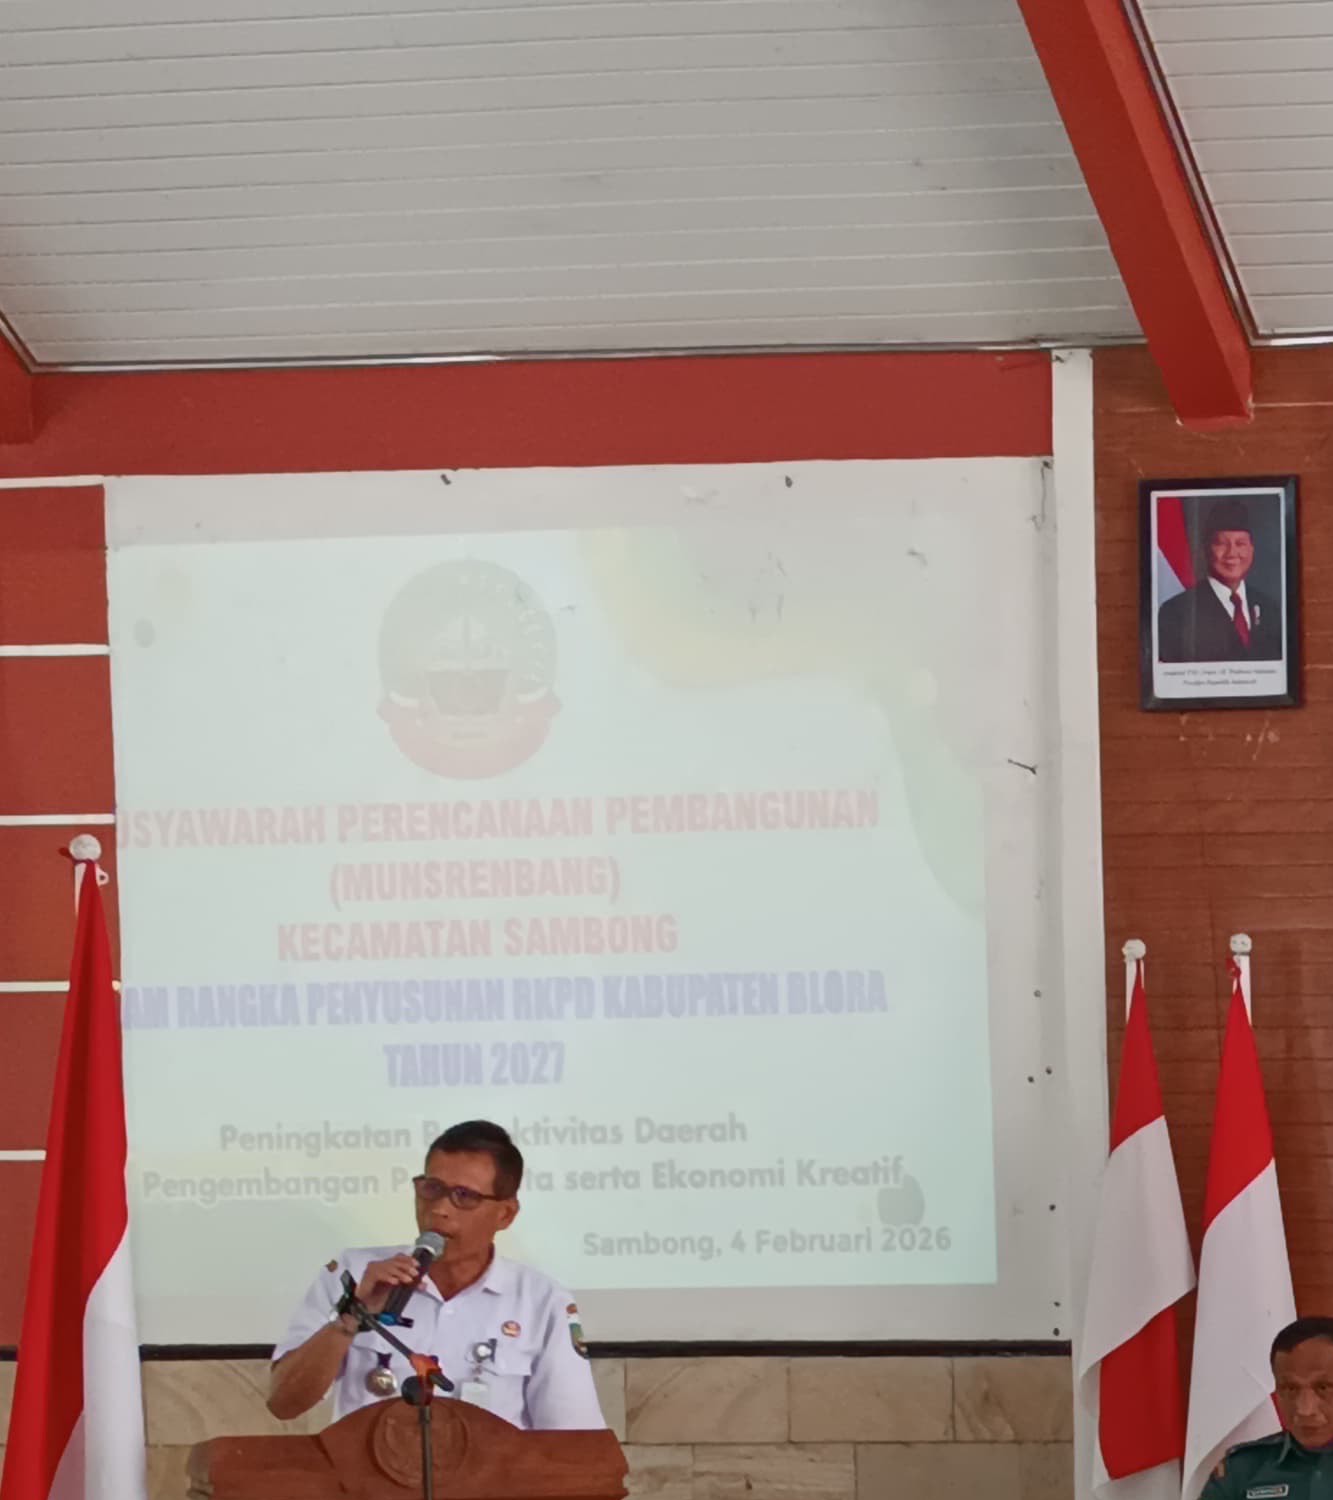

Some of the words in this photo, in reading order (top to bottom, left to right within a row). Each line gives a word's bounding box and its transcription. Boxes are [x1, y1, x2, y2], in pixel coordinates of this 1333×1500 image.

[336, 799, 594, 844] PERENCANAAN
[605, 790, 880, 835] PEMBANGUNAN
[328, 854, 623, 912] (MUNSRENBANG)
[276, 917, 493, 963] KECAMATAN
[503, 914, 679, 956] SAMBONG
[175, 982, 301, 1029] RANGKA
[306, 978, 506, 1027] PENYUSUNAN
[513, 975, 596, 1021] RKPD
[602, 971, 780, 1019] KABUPATEN
[786, 969, 889, 1014] BLORA
[382, 1042, 483, 1088] TAHUN
[490, 1041, 566, 1086] 2027
[219, 1120, 412, 1158] Peningkatan
[634, 1112, 748, 1144] Daerah
[142, 1166, 380, 1204] Pengembangan
[564, 1162, 641, 1192] serta
[651, 1158, 786, 1190] Ekonomi
[796, 1155, 905, 1186] Kreatif
[582, 1229, 723, 1261] Sambong,
[730, 1230, 747, 1254] 4
[755, 1227, 873, 1254] Februari
[881, 1226, 952, 1252] 2026
